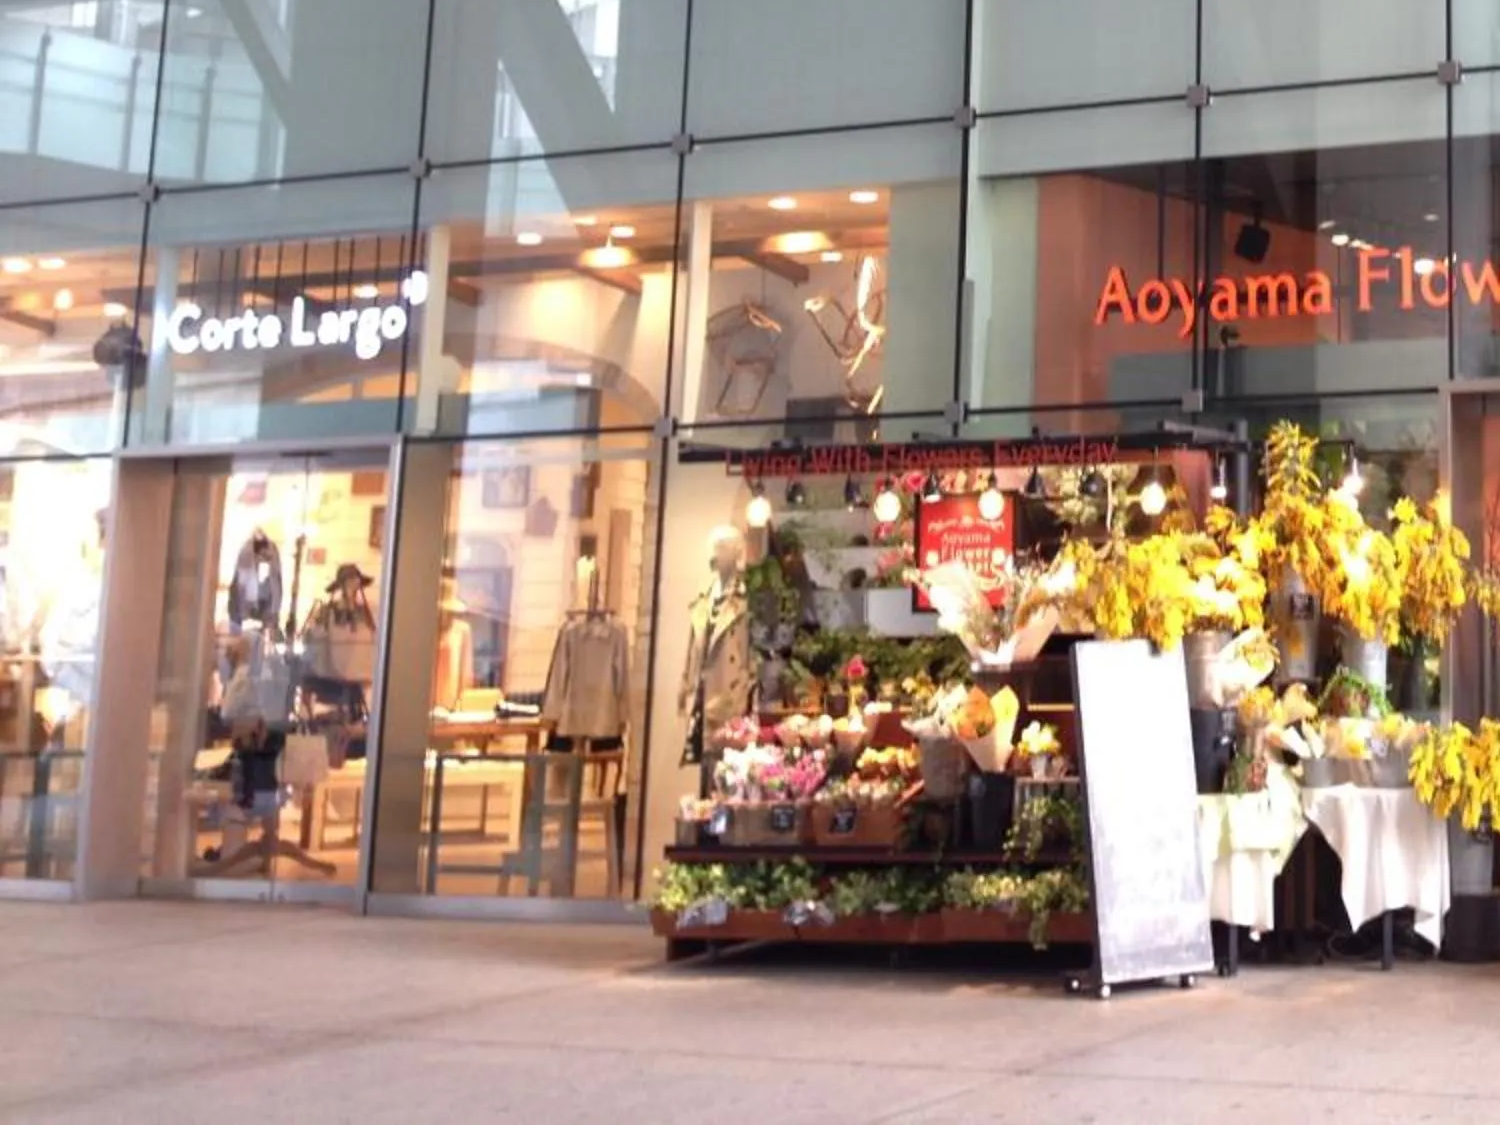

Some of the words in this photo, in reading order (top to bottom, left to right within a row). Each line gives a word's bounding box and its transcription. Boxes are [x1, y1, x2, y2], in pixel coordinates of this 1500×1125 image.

[169, 302, 282, 354] Corte
[290, 295, 407, 360] Largo
[1094, 265, 1333, 338] Aoyama
[725, 448, 802, 483] Living
[993, 434, 1119, 469] Everyday
